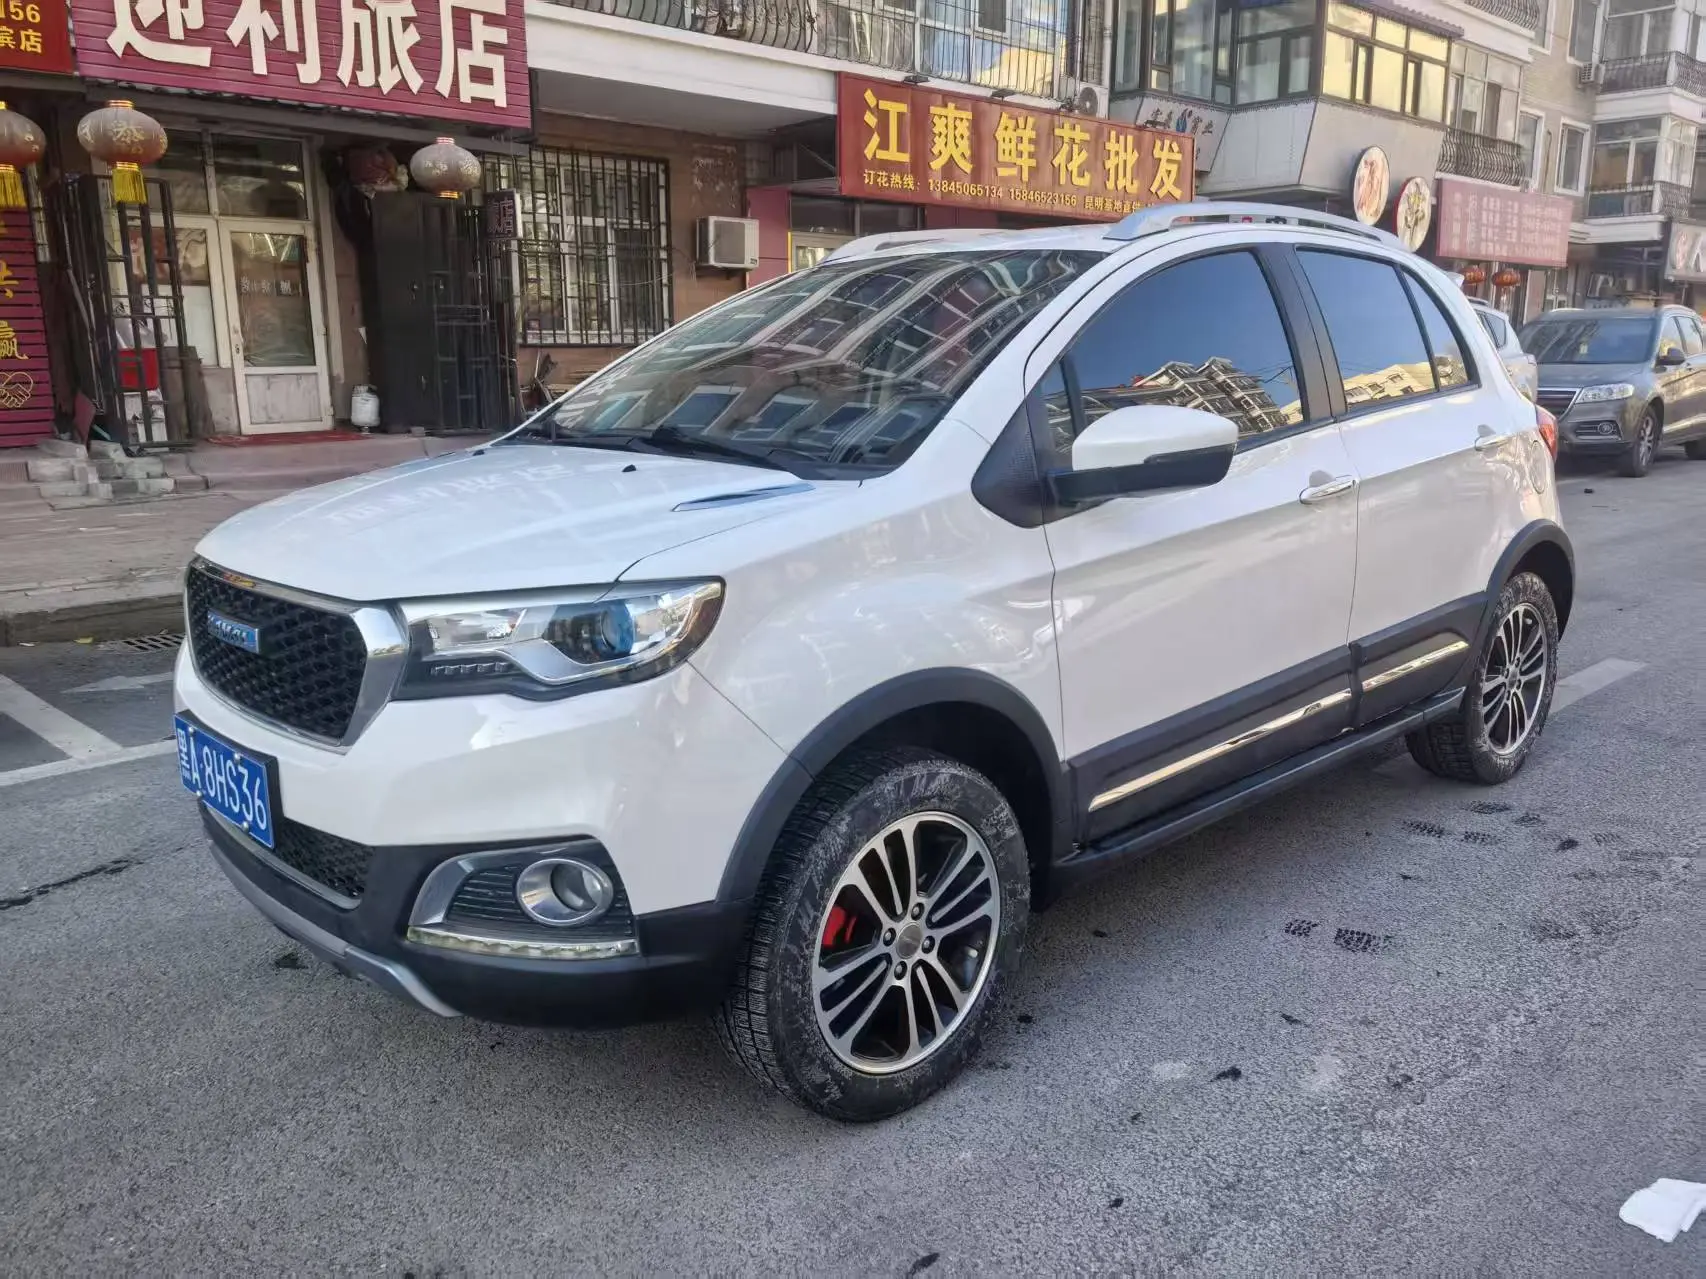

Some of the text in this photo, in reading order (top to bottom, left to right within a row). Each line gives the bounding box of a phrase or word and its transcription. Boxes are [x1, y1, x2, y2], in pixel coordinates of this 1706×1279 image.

[106, 0, 508, 107] 迎利旅店
[863, 88, 1183, 200] 江爽鲜花批发
[928, 179, 1002, 198] 13845065134
